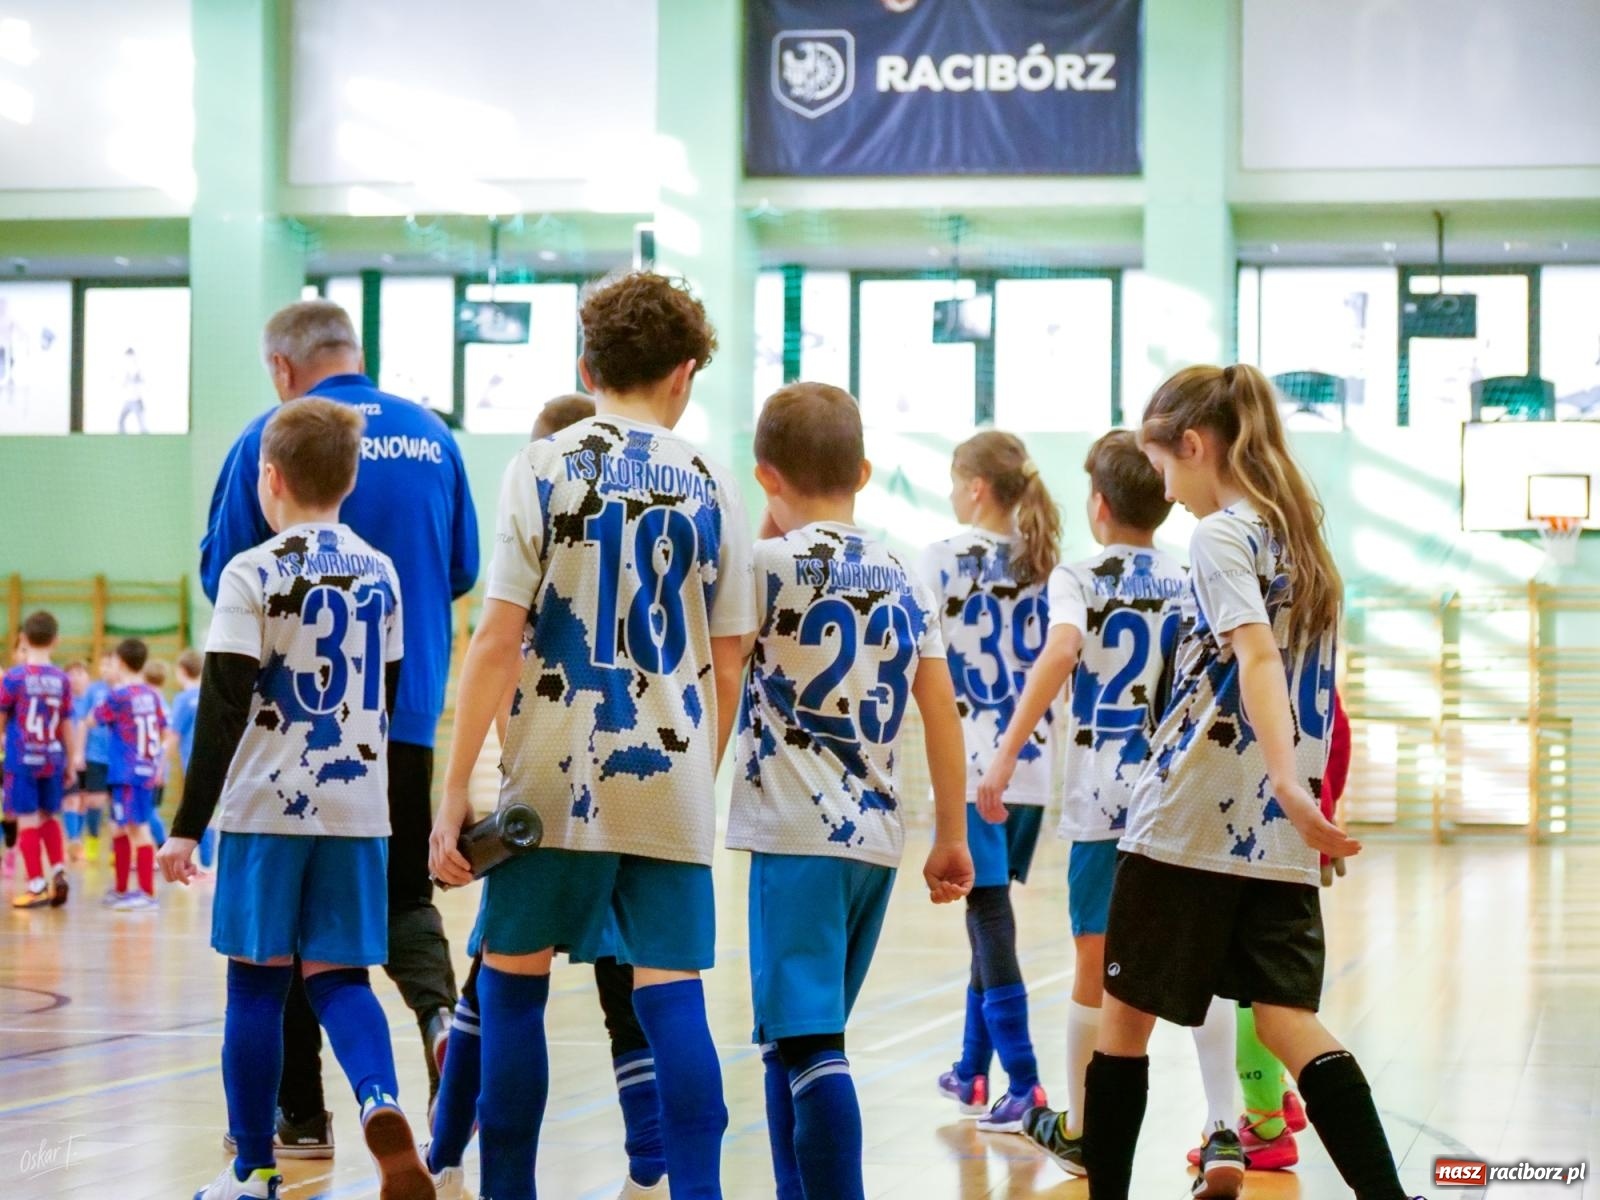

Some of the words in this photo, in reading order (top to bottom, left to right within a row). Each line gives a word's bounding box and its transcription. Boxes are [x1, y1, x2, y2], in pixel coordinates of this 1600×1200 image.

[876, 43, 1117, 92] RACIBÓRZ
[359, 434, 443, 464] RNOWAC
[564, 449, 597, 481] KS
[601, 454, 717, 510] KORNOWAC
[275, 552, 302, 577] KS
[583, 499, 698, 677] 18
[795, 558, 825, 587] KS
[292, 584, 387, 715] 31
[794, 598, 914, 744] 23
[25, 697, 61, 742] 47
[134, 713, 163, 762] 15
[1240, 1069, 1262, 1080] AKO
